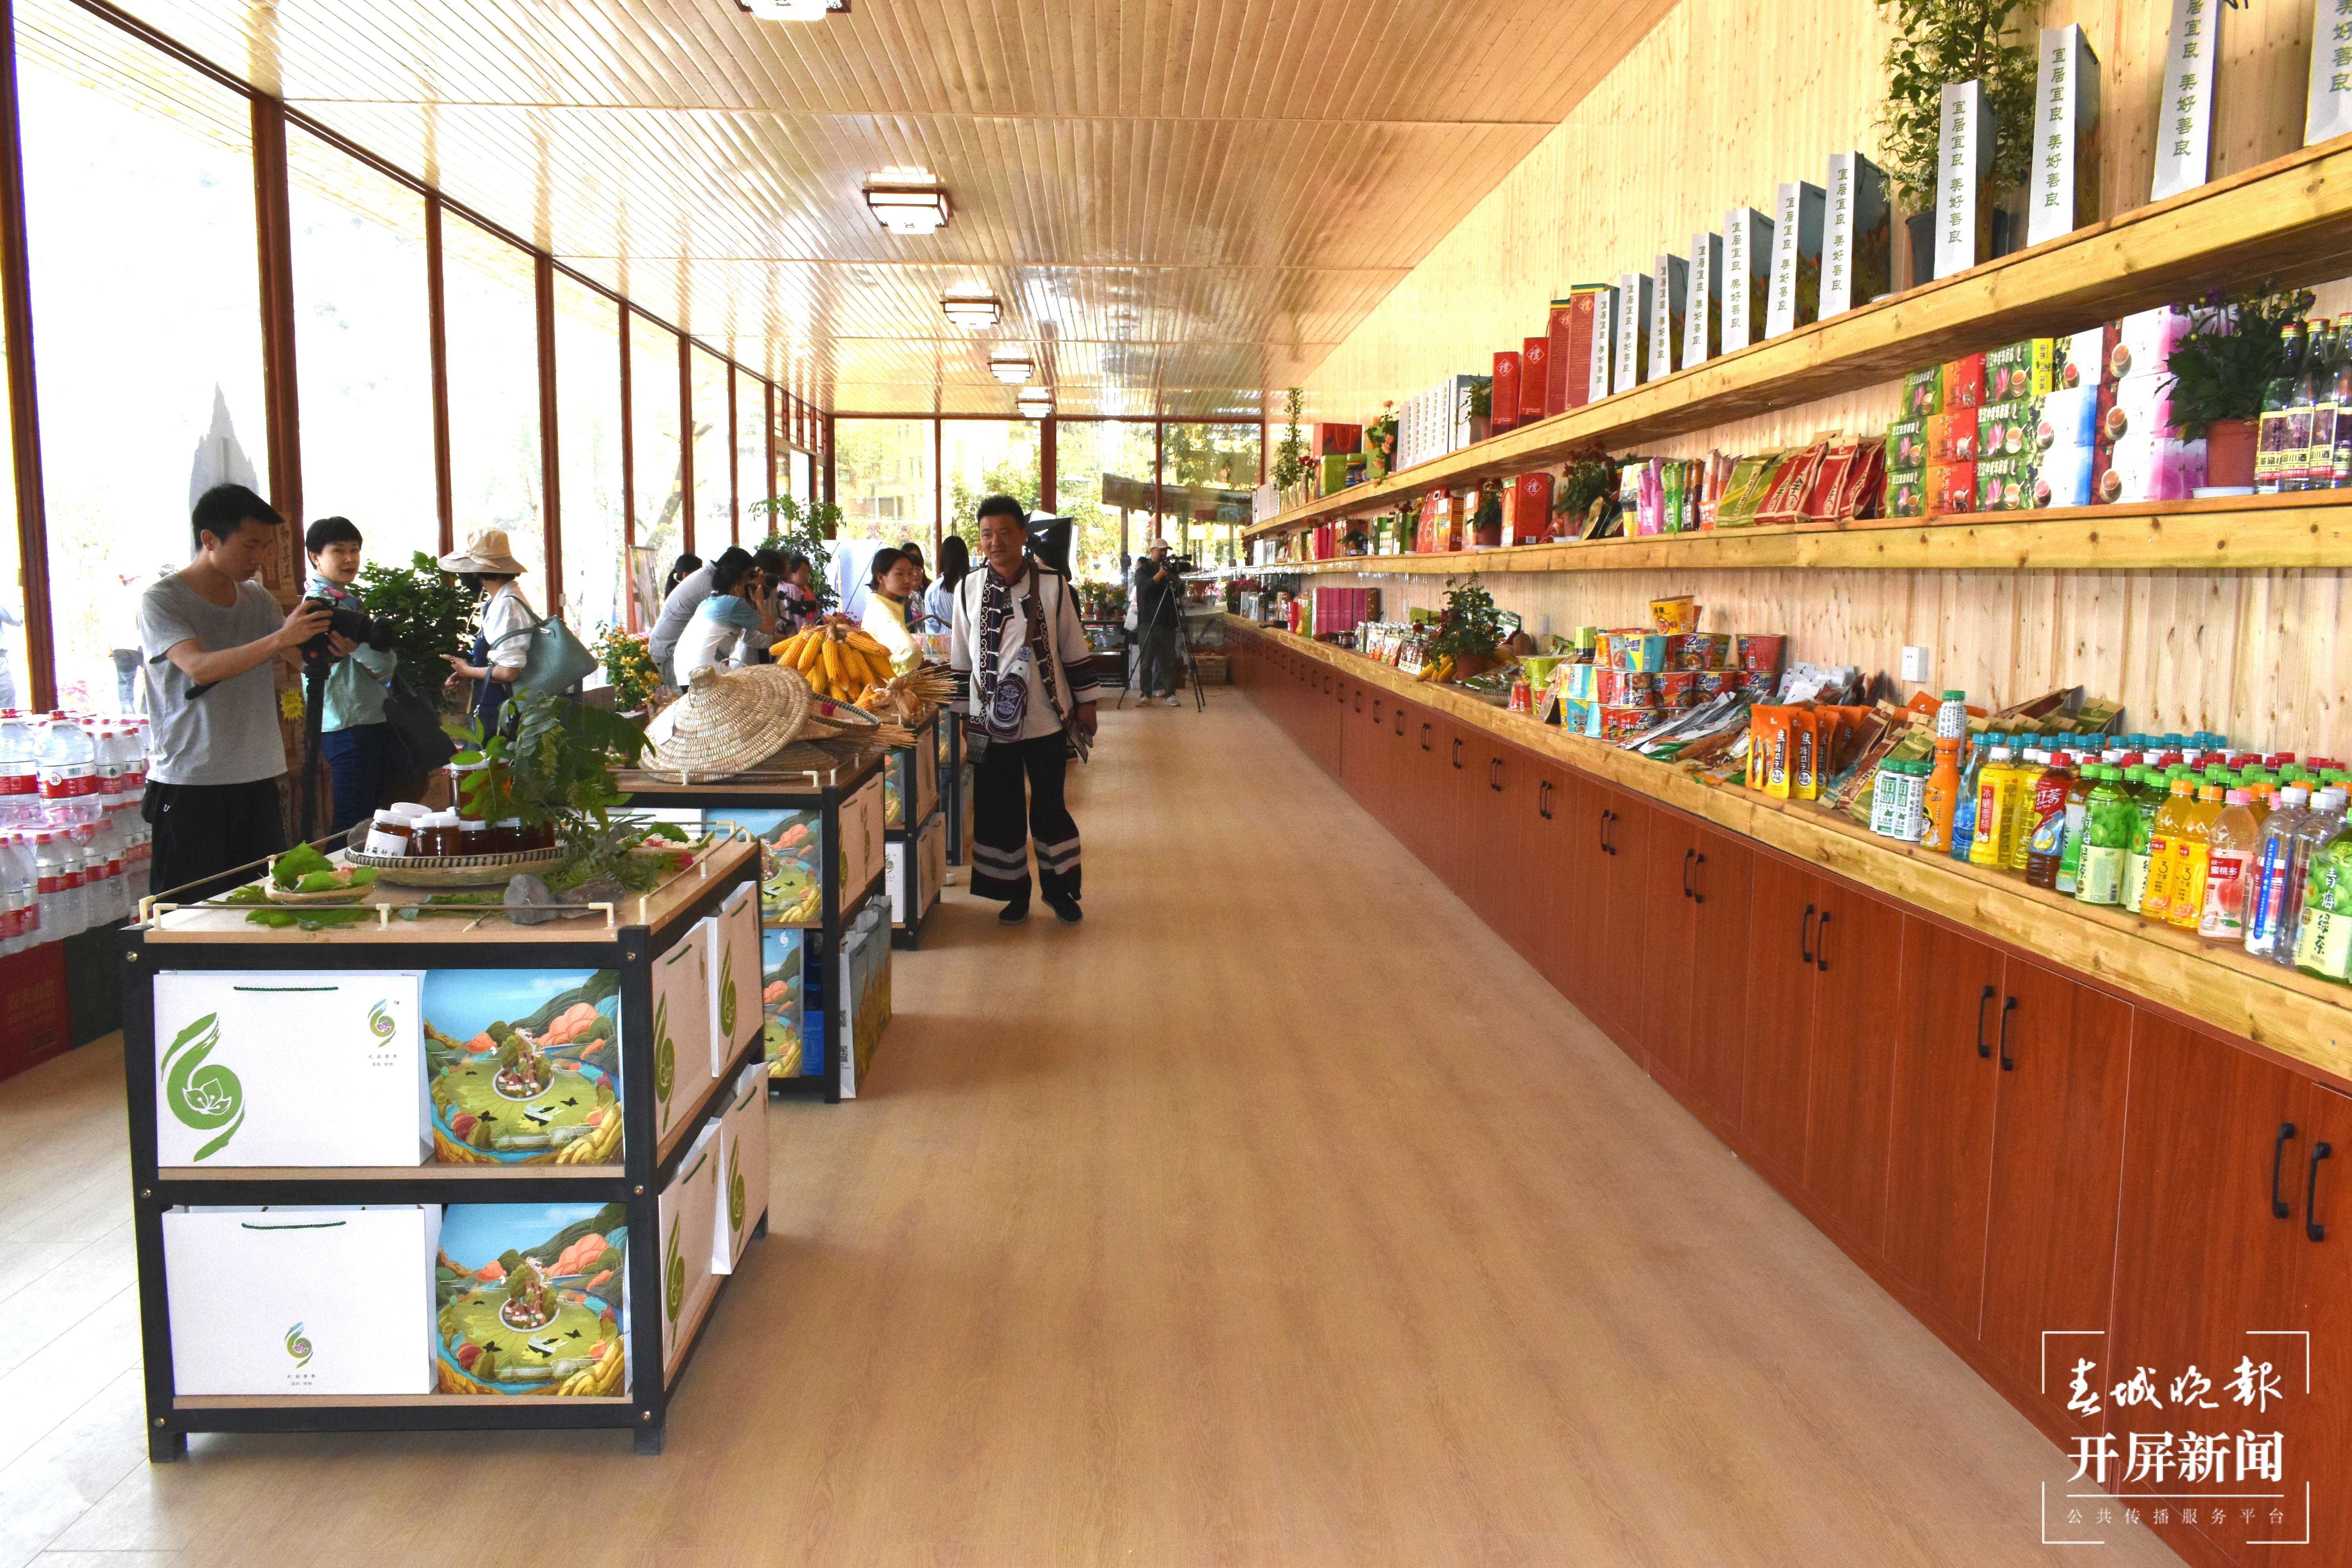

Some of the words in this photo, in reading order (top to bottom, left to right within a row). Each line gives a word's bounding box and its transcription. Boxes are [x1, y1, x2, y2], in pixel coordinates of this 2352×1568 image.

[2049, 47, 2065, 122] 宜居宜良
[1951, 100, 1965, 167] 宜居宜良
[2173, 72, 2198, 156] 美好善良
[2045, 134, 2062, 207] 美好善良
[1835, 169, 1847, 225] 宜居宜良
[1949, 178, 1964, 243] 美好善良
[1731, 222, 1741, 271] 宜居宜良
[1783, 197, 1794, 249] 宜居宜良
[1696, 246, 1705, 292] 宜居宜良
[1778, 259, 1790, 310] 美好善良
[1831, 235, 1844, 290] 美好善良
[1692, 300, 1702, 345] 美好善良
[1731, 279, 1741, 328] 美好善良
[2311, 450, 2330, 459] 小酒
[1980, 788, 1991, 829] 冰糖雪梨
[2036, 788, 2063, 805] 红茶
[2210, 866, 2238, 876] 蜜桃多
[2265, 843, 2274, 874] ALKAQUA
[2321, 866, 2337, 910] 青梅
[2314, 914, 2330, 954] 绿茶
